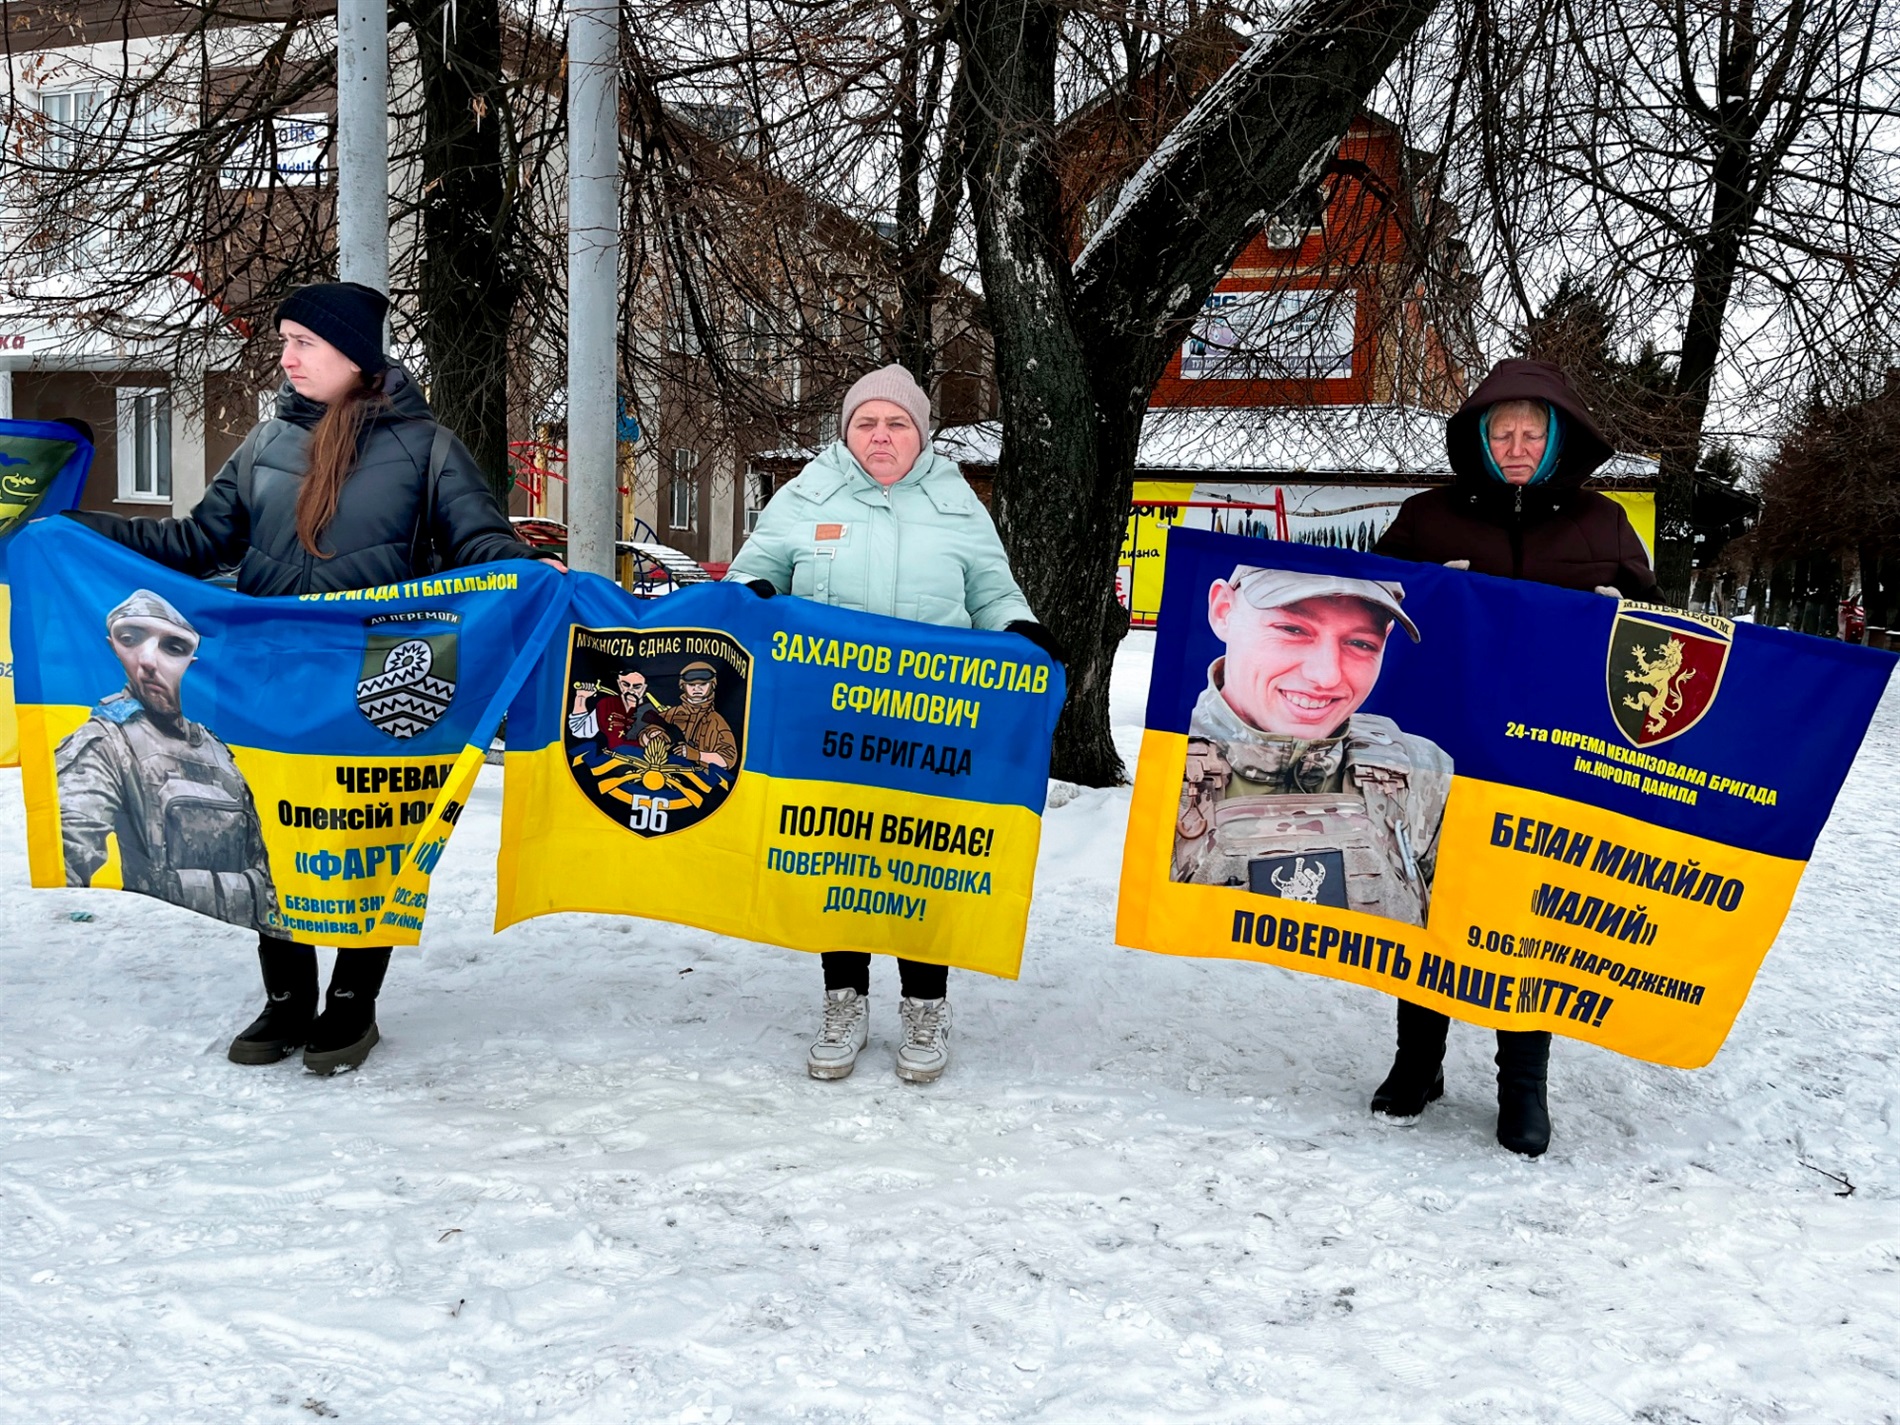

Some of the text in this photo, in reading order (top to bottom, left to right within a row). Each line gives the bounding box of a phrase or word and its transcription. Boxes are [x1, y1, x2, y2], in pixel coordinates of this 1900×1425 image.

[403, 583, 418, 598] 11
[422, 572, 518, 598] БАТАЛЬЙОН
[390, 611, 458, 624] ПЕРЕМОГИ
[1681, 609, 1730, 635] REGUM
[576, 632, 748, 680] МУЖНІСТЬ ЄДНАЄ ПОКОЛІННЯ
[771, 630, 1049, 695] ЗАХАРОВ РОСТИСЛАВ
[831, 683, 981, 729] ЄФИМОВИЧ
[821, 730, 972, 777] 56 БРИГАДА
[1505, 721, 1778, 807] 24-та ОКРЕМА МЕХАНІЗОВАНА БРИГАДА
[278, 799, 394, 831] Олексій
[629, 795, 668, 833] 56
[1640, 776, 1699, 807] ДАНИЛА
[778, 804, 996, 859] ПОЛОН ВБИВАЄ!
[767, 846, 992, 895] ПОВЕРНІТЬ ЧОЛОВІКА
[1489, 811, 1745, 913] БЕЛАН МИХАЙЛО
[285, 894, 356, 915] БЕЗВІСТИ
[822, 884, 927, 922] ДОДОМУ!
[1530, 882, 1659, 947] «МАЛИЙ»
[1231, 909, 1614, 1029] ПОВЕРНІТЬ НАШЕ ЖИТТЯ!
[1466, 924, 1706, 1006] 9.06.2001 РІК НАРОДЖЕННЯ
